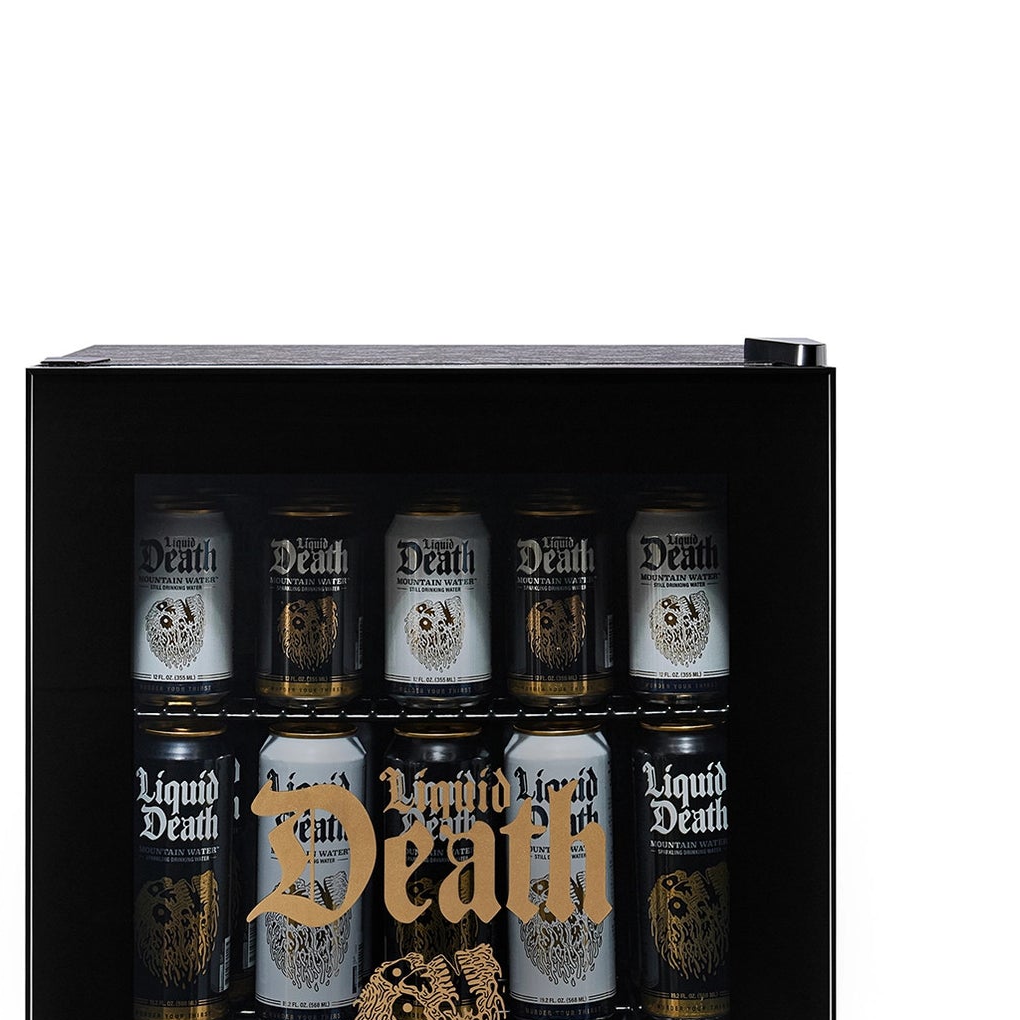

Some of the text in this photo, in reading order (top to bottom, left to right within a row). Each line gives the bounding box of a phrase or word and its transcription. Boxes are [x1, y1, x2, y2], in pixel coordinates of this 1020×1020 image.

[163, 537, 197, 550] Liquid
[296, 536, 328, 551] Liquid
[423, 538, 455, 551] Liquid
[542, 536, 574, 551] Liquid
[666, 534, 698, 547] Liquid
[139, 539, 218, 574] Death
[269, 537, 350, 576] Death
[396, 540, 476, 576] Death
[516, 537, 596, 576] Death
[639, 534, 719, 571] Death
[186, 576, 217, 585] WATER
[318, 577, 348, 585] WATER
[396, 577, 474, 587] MOUNTAIN WATER
[640, 573, 718, 582] MOUNTAIN WATER
[135, 766, 220, 817] Liquid
[642, 760, 728, 809] Liquid
[379, 766, 511, 819] Liquid
[139, 804, 220, 842] Death
[650, 796, 730, 836] Death
[187, 845, 218, 856] WATER
[650, 839, 697, 850] MOUNTAIN
[247, 779, 614, 928] Death
[318, 849, 350, 858] WATER
